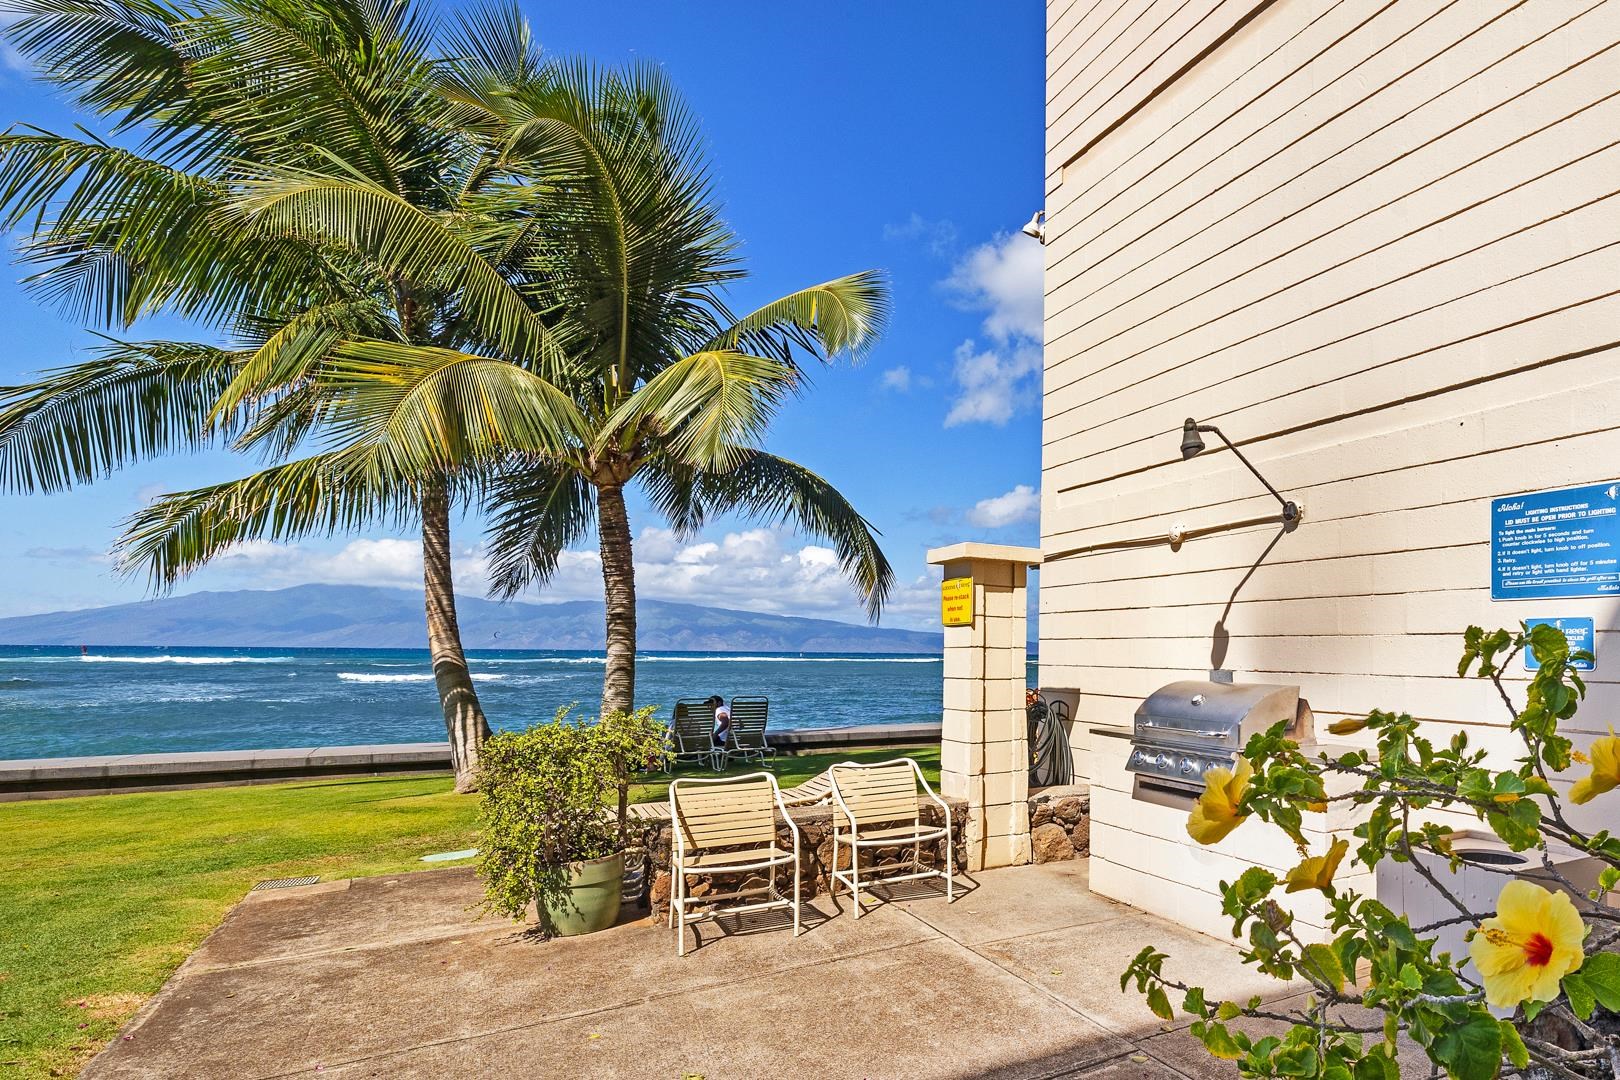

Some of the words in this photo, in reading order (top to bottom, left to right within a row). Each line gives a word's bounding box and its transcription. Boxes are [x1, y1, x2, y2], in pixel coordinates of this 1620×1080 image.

[1497, 502, 1525, 512] Aloha!
[1525, 508, 1548, 516] LIGHTING
[1550, 503, 1589, 512] INSTRUCTIONS
[1588, 507, 1616, 516] LIGHTING
